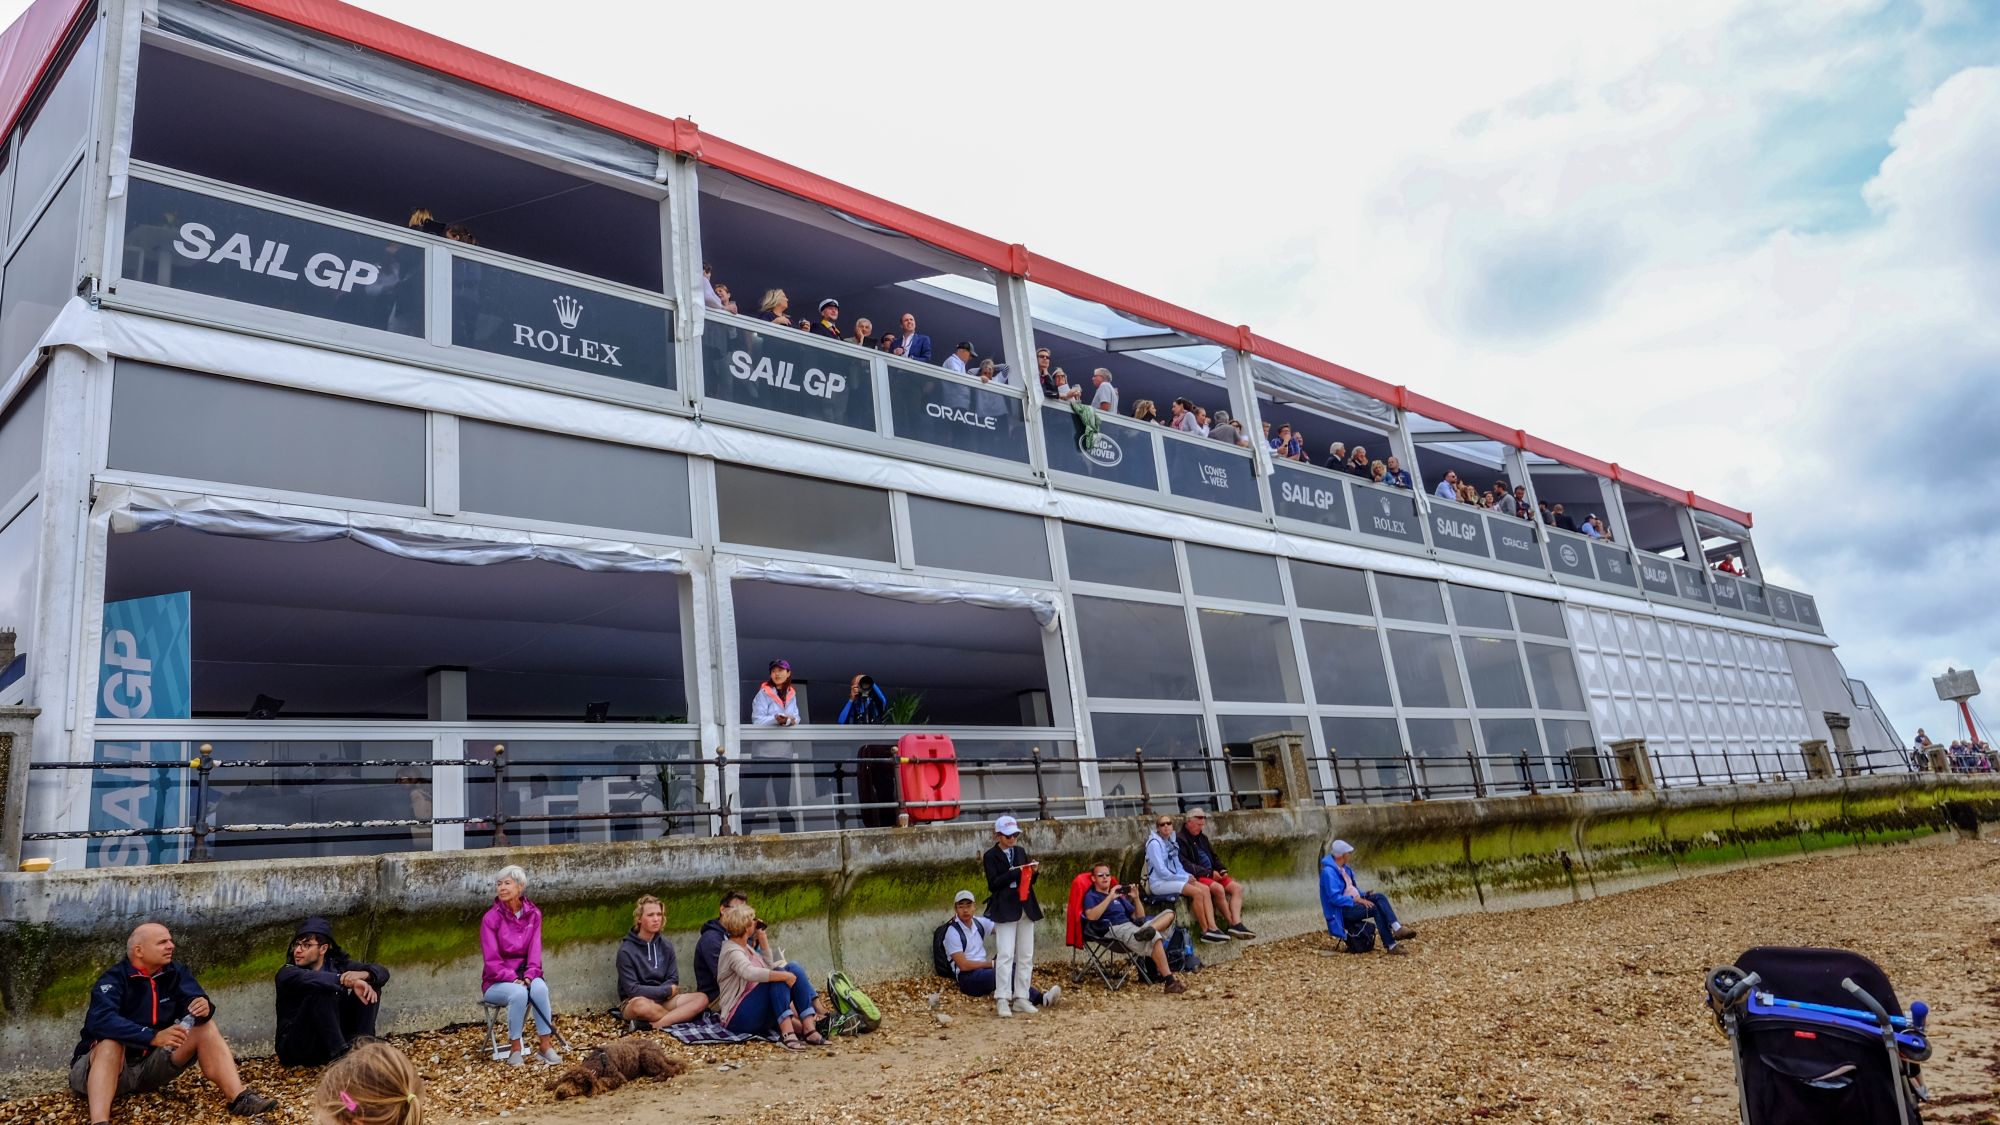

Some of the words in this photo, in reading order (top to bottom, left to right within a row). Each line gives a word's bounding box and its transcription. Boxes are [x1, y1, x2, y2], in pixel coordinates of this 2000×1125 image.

[513, 323, 622, 366] ROLEX
[926, 402, 996, 430] ORACLE
[1204, 465, 1227, 479] COWES
[1210, 476, 1229, 489] WEEK
[1373, 516, 1407, 534] ROLEX
